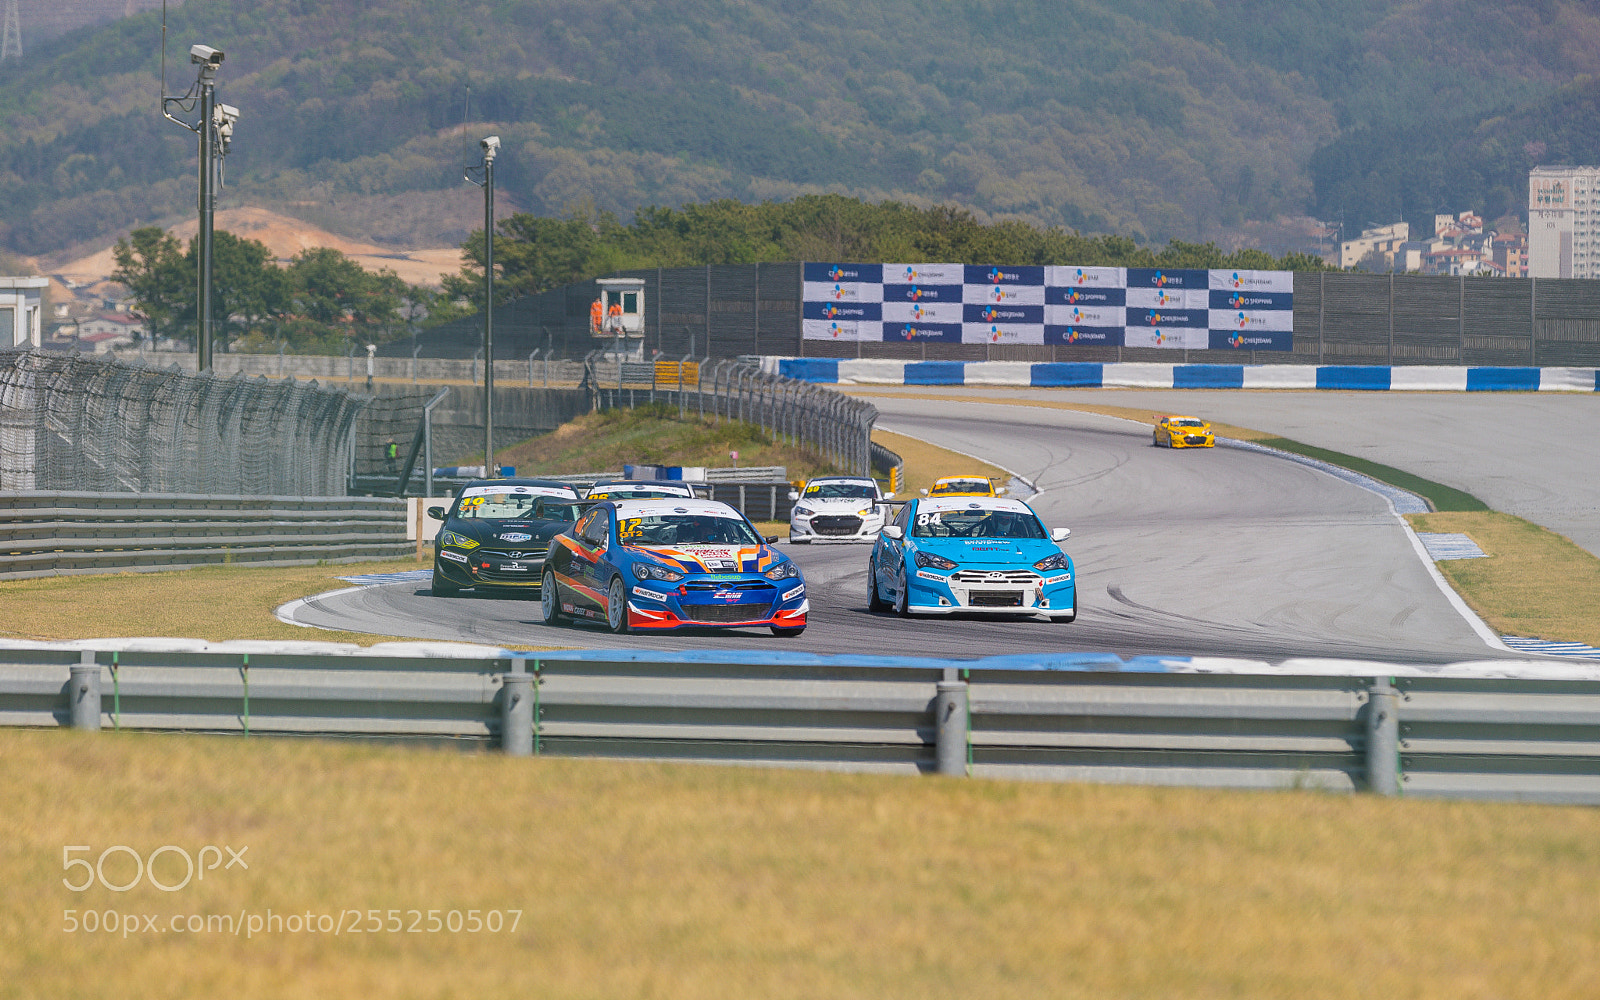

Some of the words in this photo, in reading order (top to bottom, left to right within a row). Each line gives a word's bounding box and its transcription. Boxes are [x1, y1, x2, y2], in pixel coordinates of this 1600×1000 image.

[463, 497, 485, 506] 10
[619, 518, 642, 533] 17
[917, 513, 942, 526] 84
